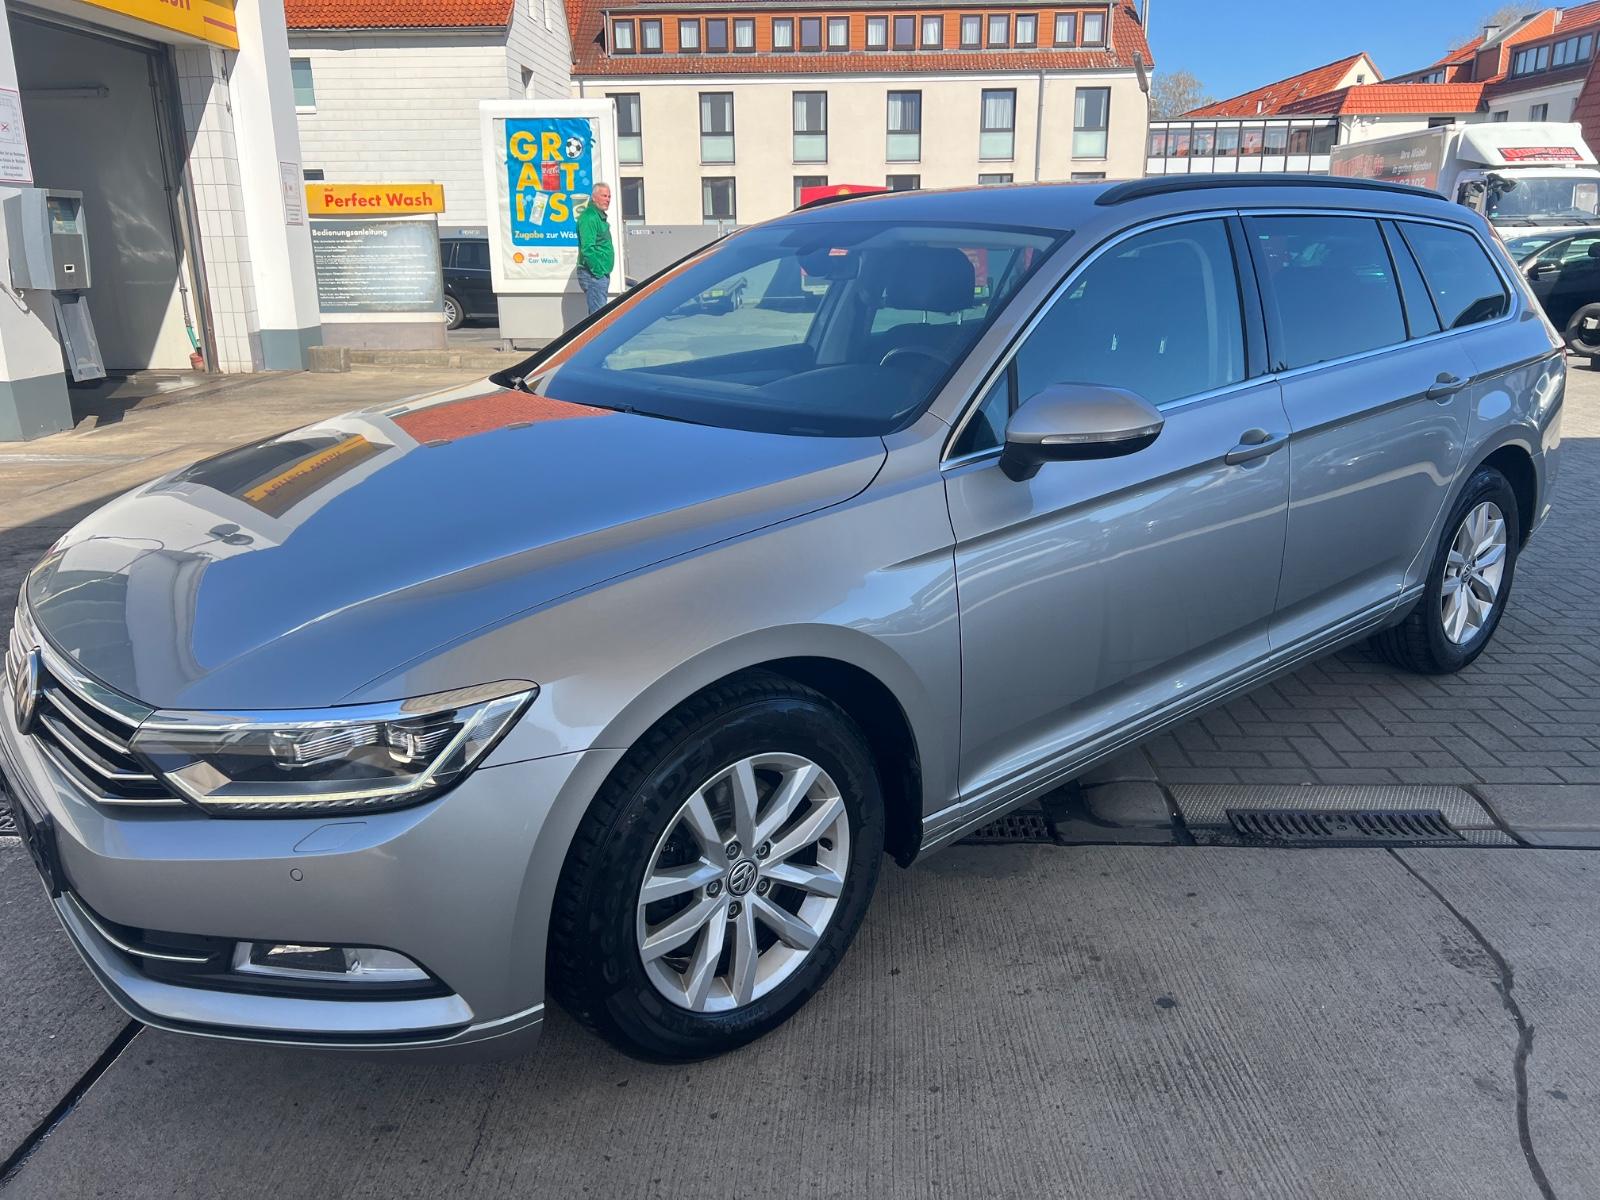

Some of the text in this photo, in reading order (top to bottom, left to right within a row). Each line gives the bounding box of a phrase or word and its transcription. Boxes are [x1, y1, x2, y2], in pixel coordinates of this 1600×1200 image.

[509, 130, 564, 161] GR
[324, 192, 433, 207] Perfect Wash
[312, 228, 388, 237] Bedienungsanleitung
[514, 230, 578, 240] Zugabe zur Wäs
